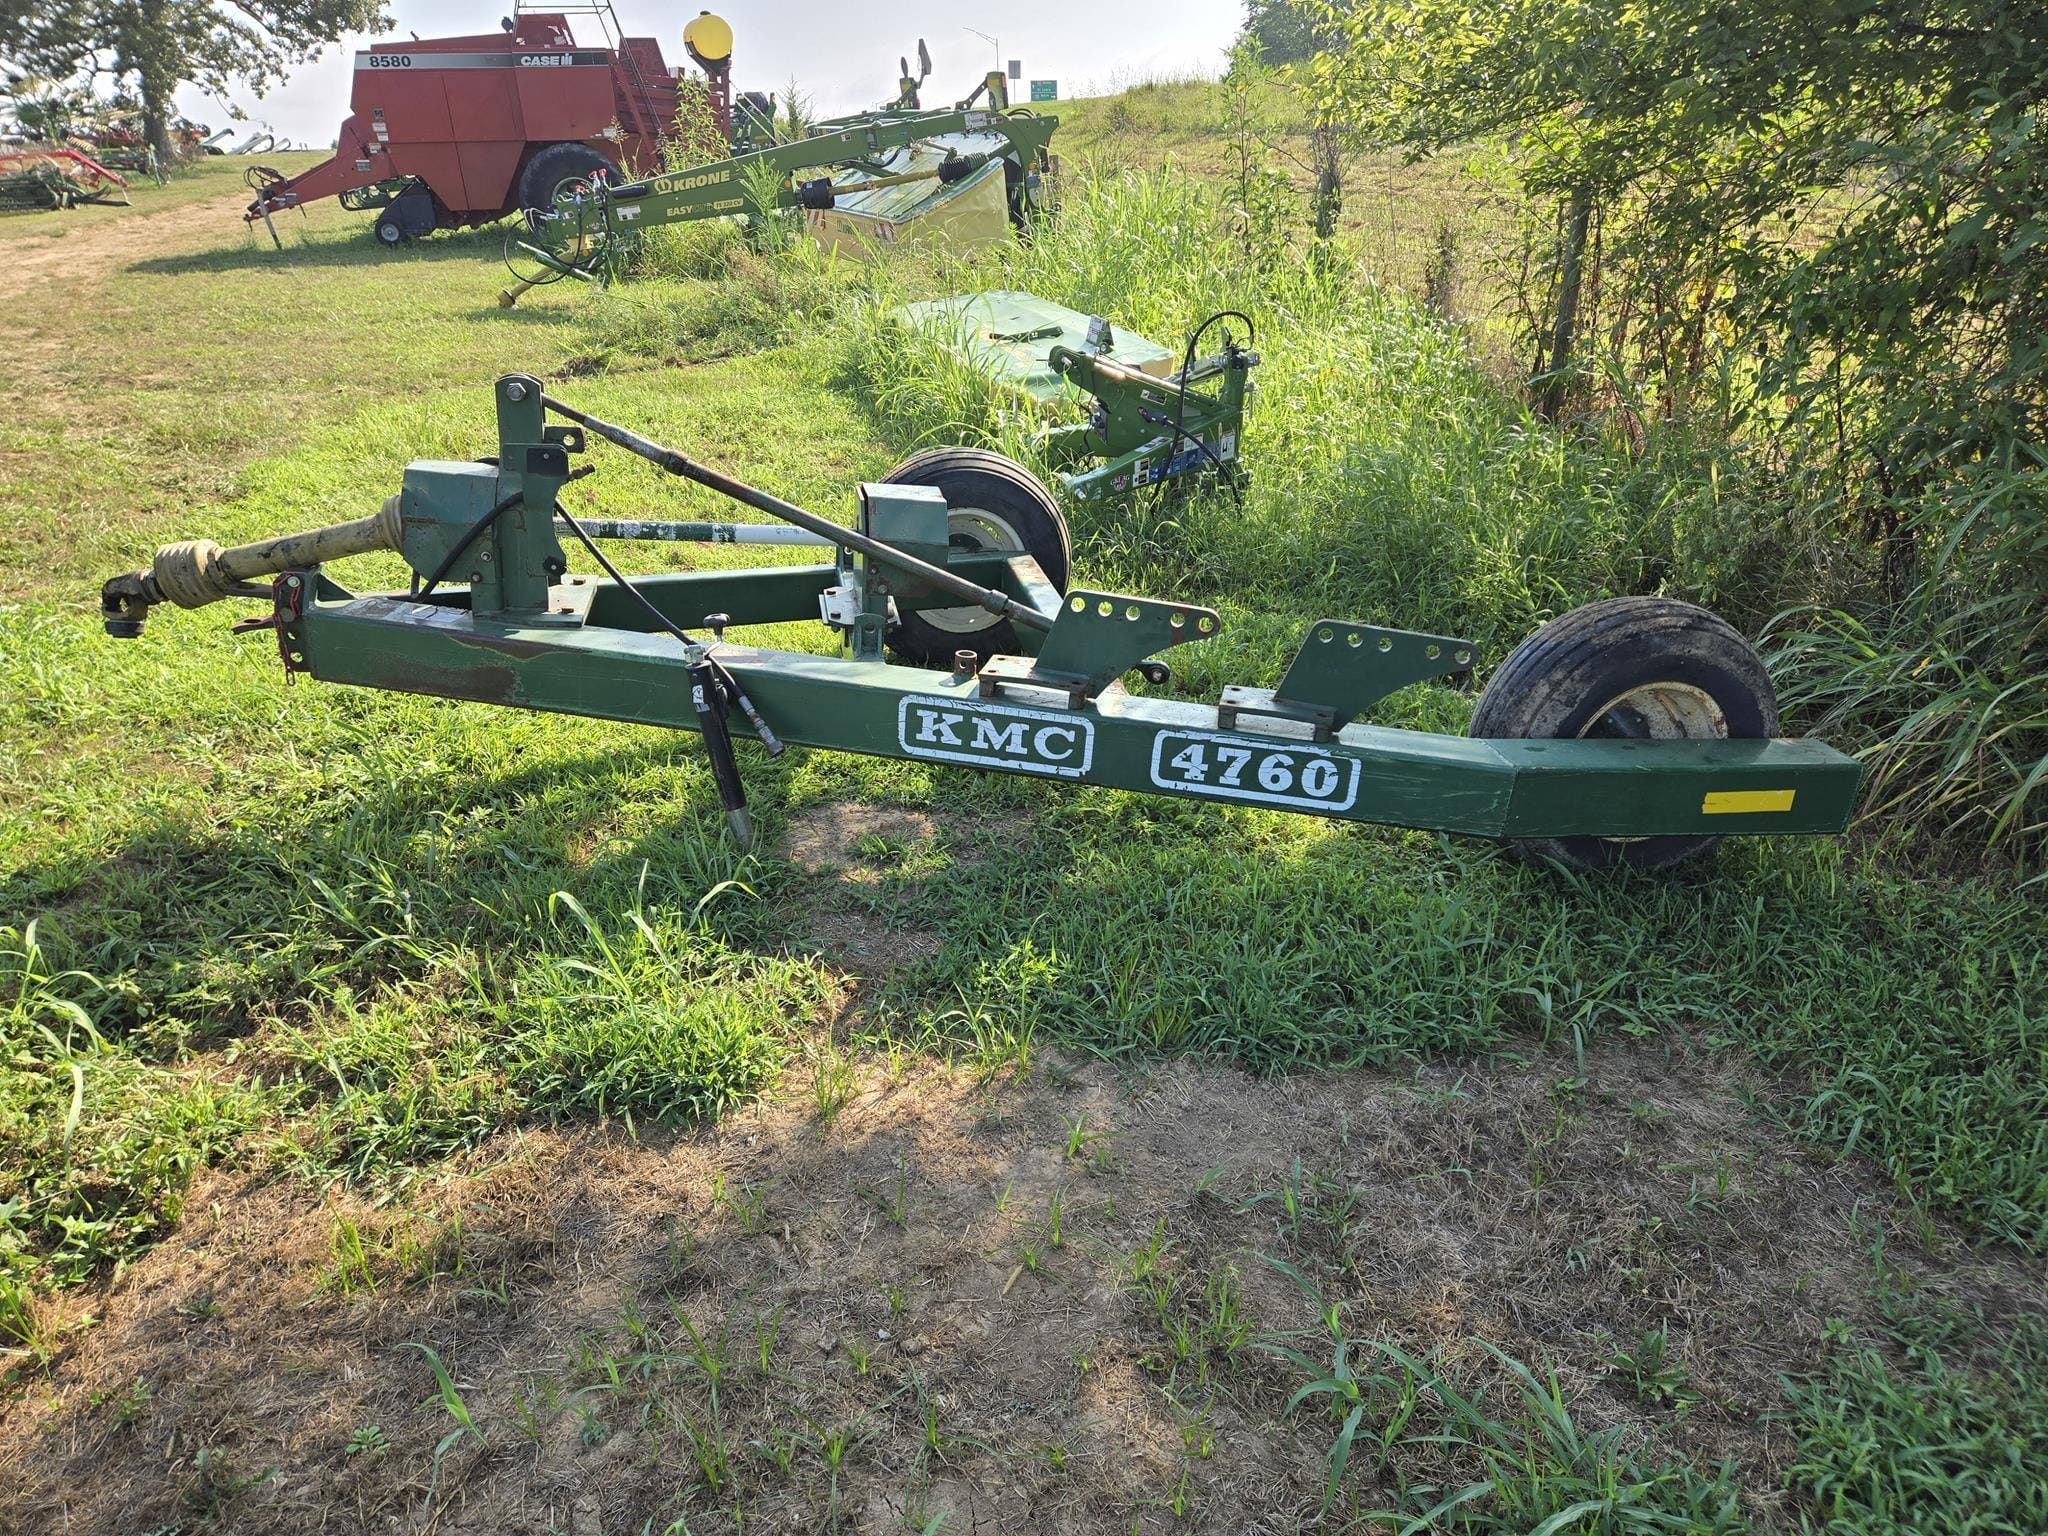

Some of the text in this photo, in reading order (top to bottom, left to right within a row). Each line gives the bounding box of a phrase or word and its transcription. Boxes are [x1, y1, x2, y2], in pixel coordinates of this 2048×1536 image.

[369, 55, 412, 68] 8580
[520, 55, 560, 66] CASE
[673, 170, 730, 192] KRONE
[915, 709, 1076, 760] KMC
[1171, 743, 1339, 798] 4760
